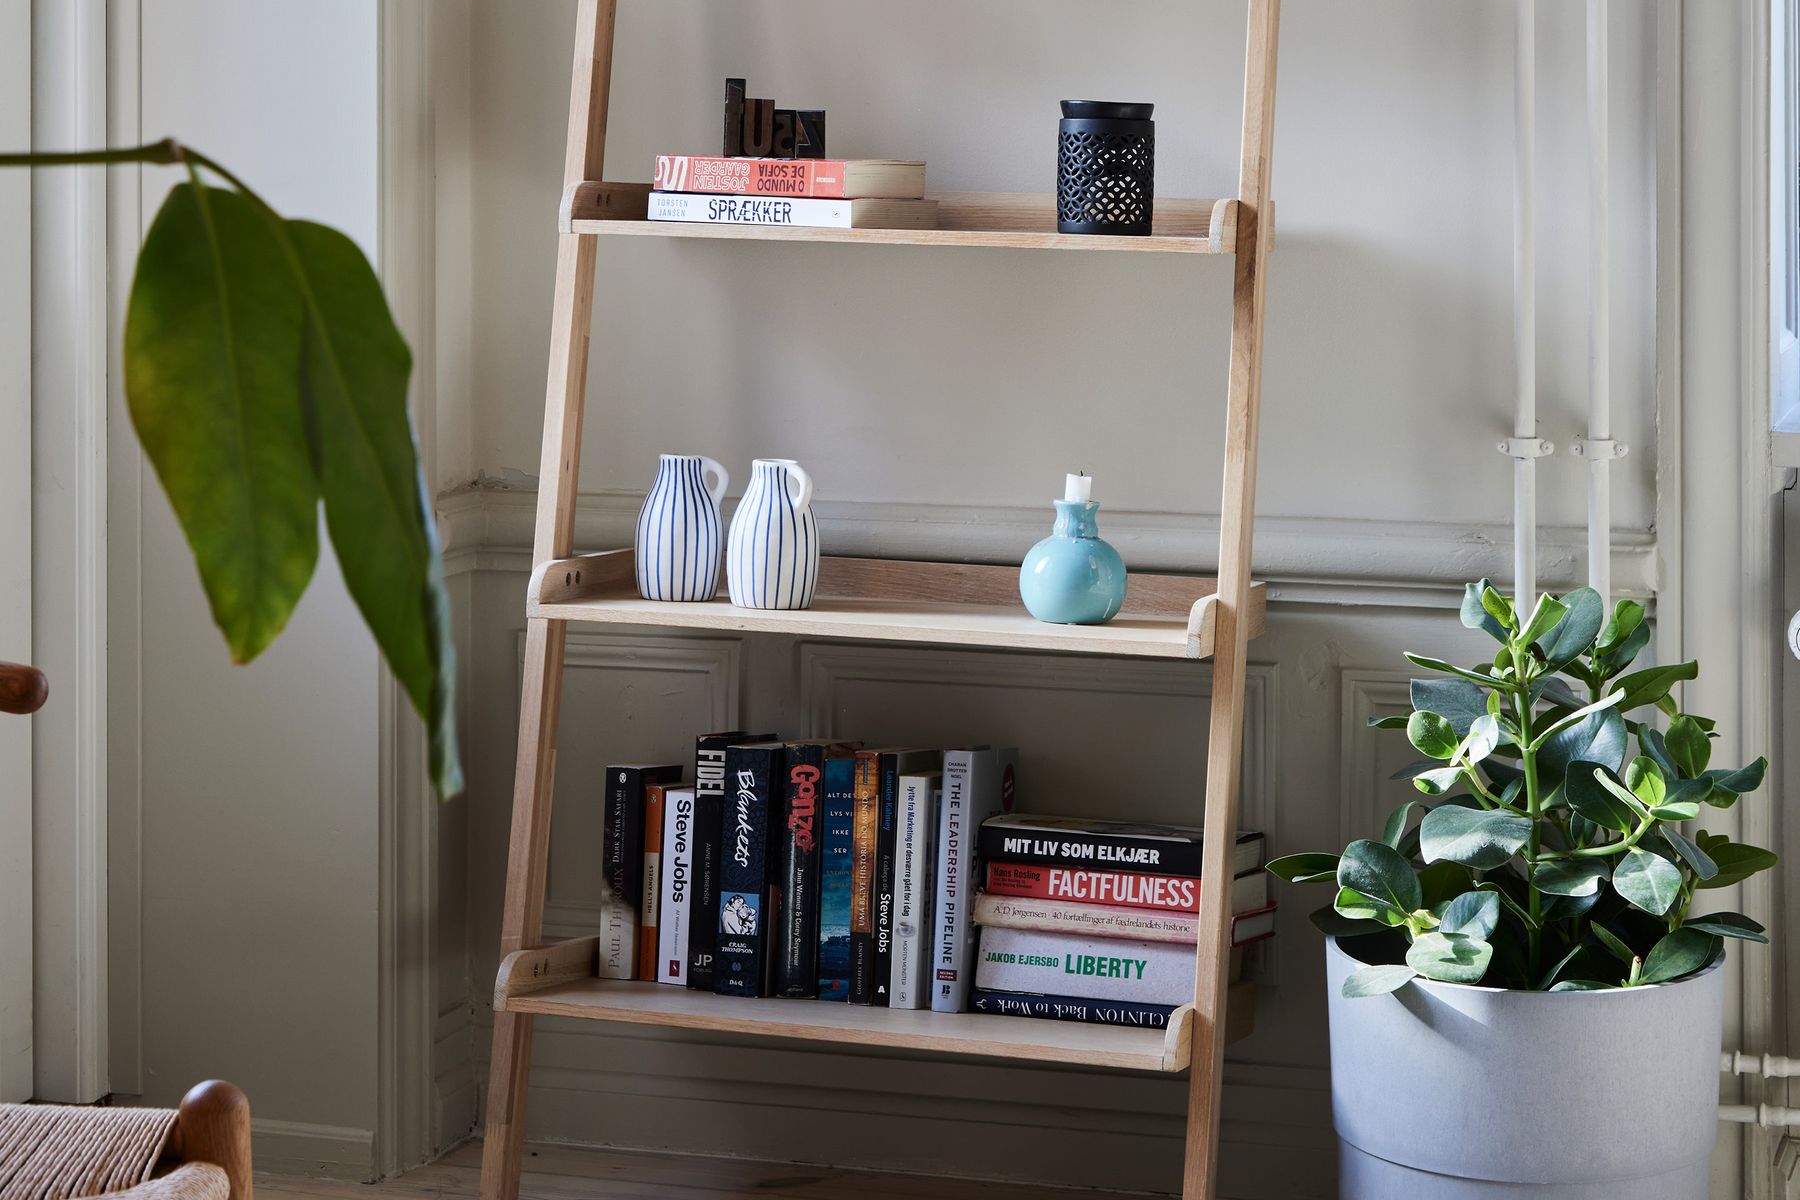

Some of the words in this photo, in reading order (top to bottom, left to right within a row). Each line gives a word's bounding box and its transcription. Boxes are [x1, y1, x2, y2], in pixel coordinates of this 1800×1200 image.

[694, 160, 750, 176] GAARDER
[758, 164, 788, 178] SOFIA
[791, 166, 804, 178] DE
[693, 176, 750, 191] JOSTEIN
[757, 178, 796, 192] MUNDO
[798, 180, 804, 192] O
[657, 198, 688, 208] TORSTEN
[658, 209, 686, 217] JANSEN
[708, 198, 792, 224] SPRÆKKER
[696, 750, 726, 798] FIDEL
[886, 770, 894, 802] Leander
[907, 786, 916, 802] Jytte
[950, 783, 961, 808] THE
[861, 790, 869, 824] MUNDO
[884, 802, 893, 831] Kahney
[908, 802, 916, 811] fra
[675, 800, 692, 854] Steve
[734, 769, 758, 868] Blankets
[905, 812, 914, 842] Marketing
[861, 826, 868, 838] DO
[612, 841, 620, 862] DARK
[704, 843, 712, 860] ANNE
[906, 842, 912, 850] er
[946, 814, 960, 898] LEADERSHIP
[1004, 838, 1032, 854] MIT
[1034, 840, 1058, 856] LIV
[1061, 842, 1094, 859] SOM
[1098, 846, 1160, 864] ELKJÆR
[672, 856, 688, 903] Jobs
[796, 868, 804, 884] Jann
[882, 861, 890, 882] cabeça
[993, 867, 1012, 878] Hans
[1014, 869, 1040, 882] Rosling
[882, 883, 889, 892] de
[1048, 868, 1194, 908] FACTFULNESS
[610, 867, 624, 931] THROUX
[795, 885, 803, 911] Wenner
[880, 894, 891, 924] Steve
[902, 904, 911, 916] dag
[794, 918, 802, 938] Corey
[1052, 912, 1062, 920] 40
[1063, 912, 1105, 925] fortællinger
[1106, 916, 1113, 924] af
[1115, 916, 1161, 929] fædrelandets
[1164, 922, 1190, 932] historie
[878, 926, 890, 953] Jobs
[943, 902, 955, 964] PIPELINE
[608, 936, 620, 968] PAUL
[694, 954, 713, 966] JP
[986, 952, 1016, 964] JAKOB
[1018, 955, 1059, 968] EJERSBO
[1065, 954, 1148, 980] LIBERTY
[998, 1000, 1032, 1015] Work
[1036, 1002, 1048, 1013] to
[1054, 1004, 1087, 1020] Back
[1096, 1008, 1164, 1026] CLINTON
